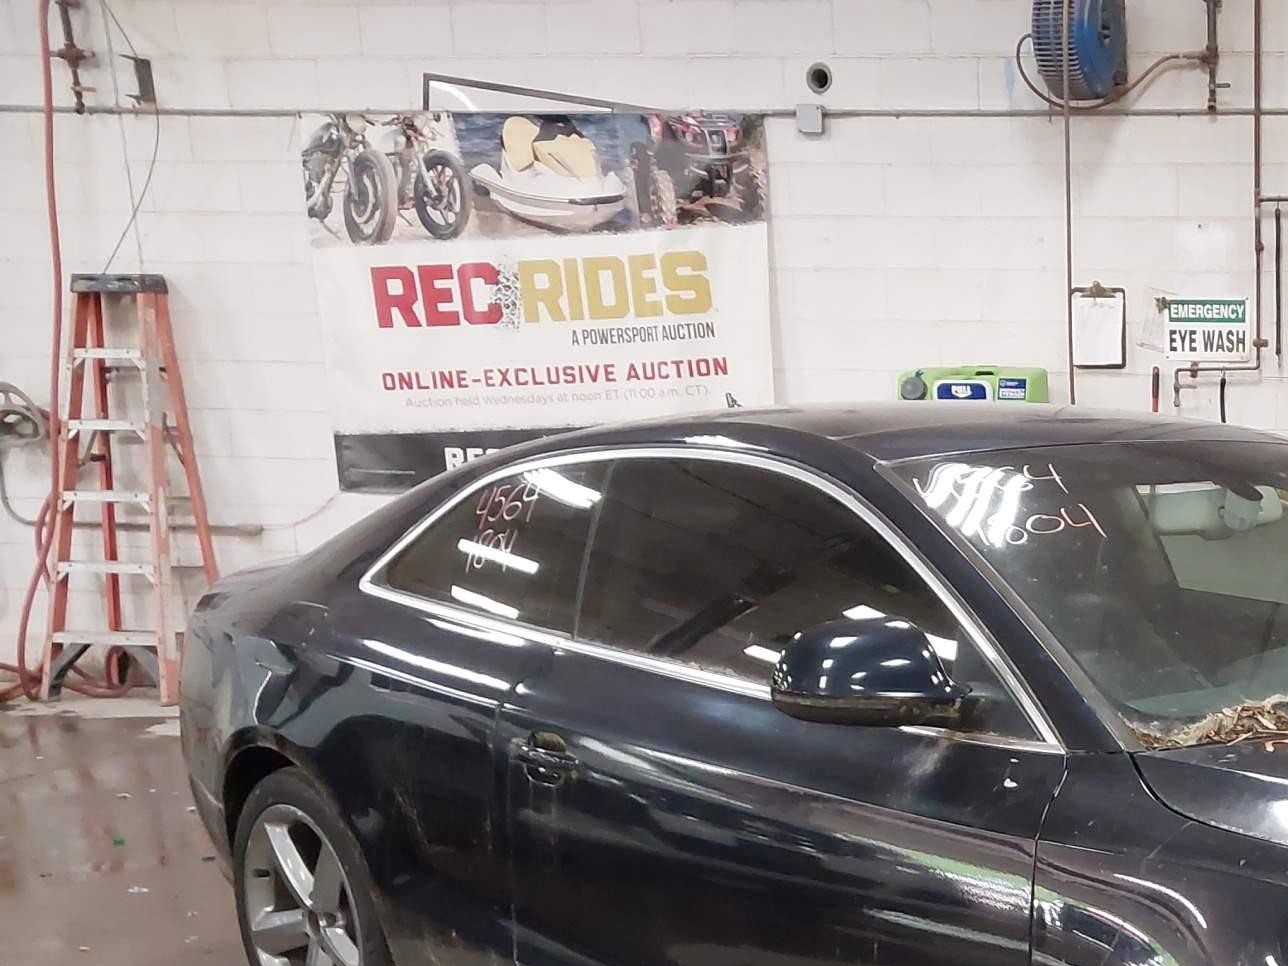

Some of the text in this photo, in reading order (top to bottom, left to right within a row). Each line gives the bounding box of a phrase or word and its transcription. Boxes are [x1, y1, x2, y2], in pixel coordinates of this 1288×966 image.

[370, 250, 715, 329] REC RIDES
[1170, 303, 1246, 319] EMERGENCY
[572, 321, 716, 346] A POWERSPORT AUCTION
[1169, 329, 1247, 353] EYE WASH
[382, 356, 729, 392] ONLINE-EXCLUSIVE AUCTION
[405, 395, 453, 408] Auction
[456, 395, 480, 406] held
[482, 392, 555, 406] Wednesdays
[557, 391, 569, 401] at
[572, 391, 601, 401] noon
[605, 389, 619, 400] ET
[444, 447, 501, 470] RE
